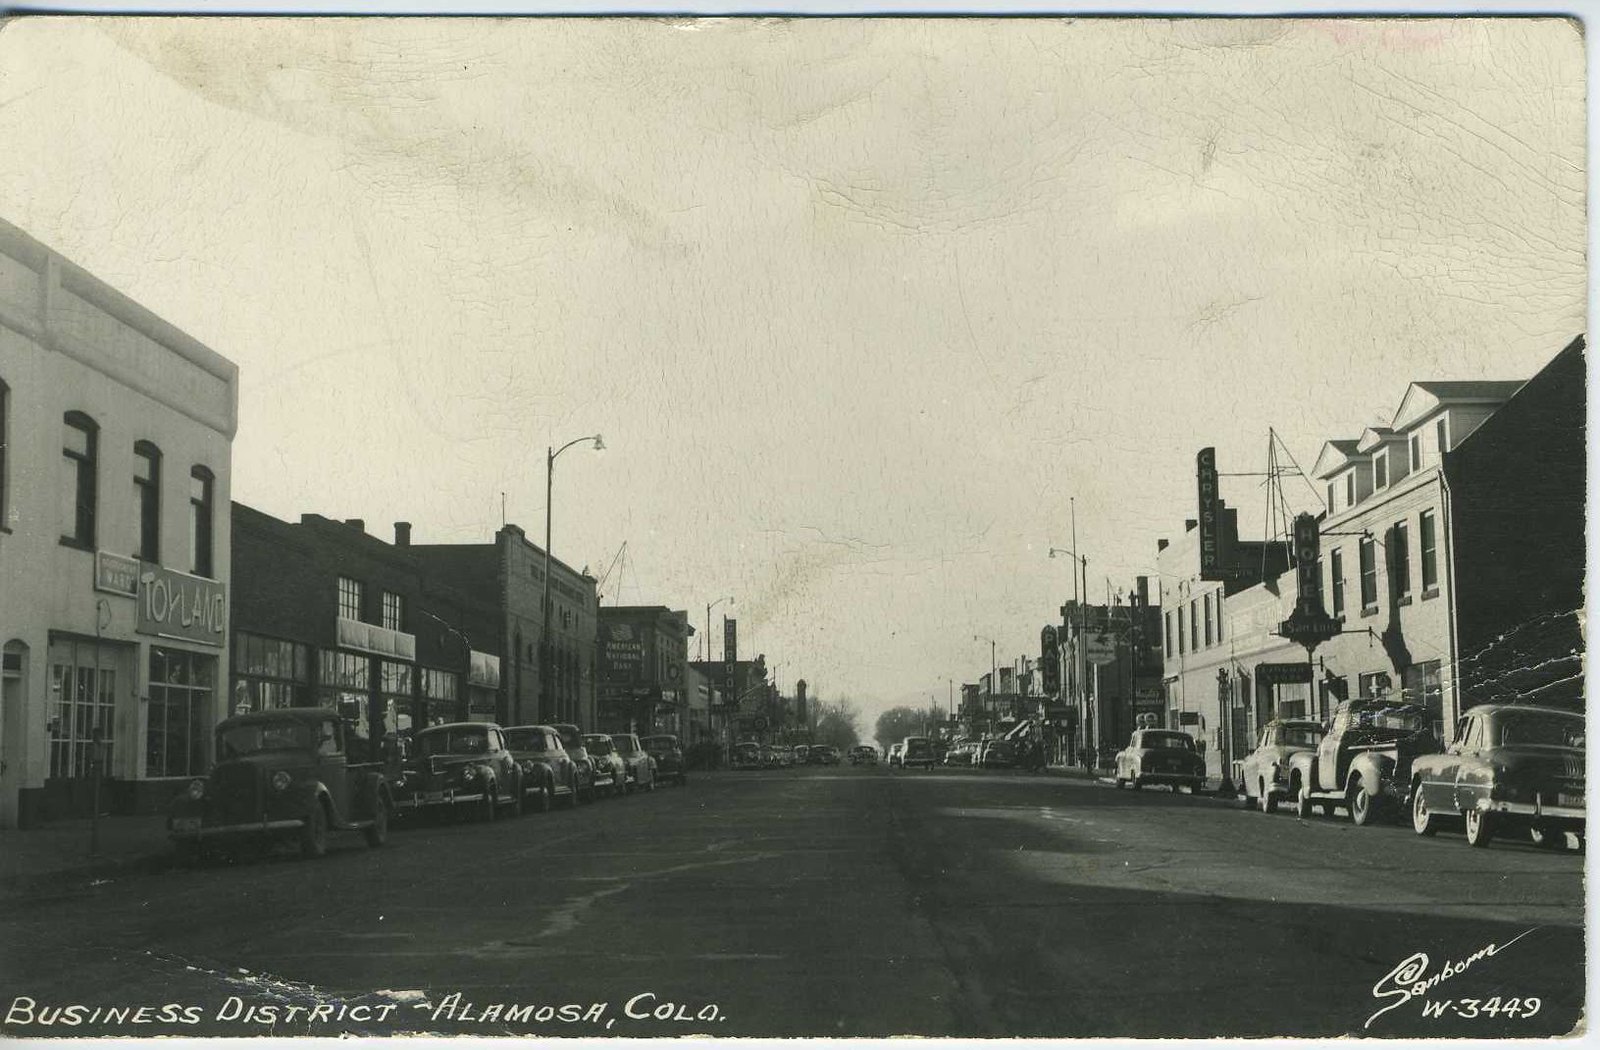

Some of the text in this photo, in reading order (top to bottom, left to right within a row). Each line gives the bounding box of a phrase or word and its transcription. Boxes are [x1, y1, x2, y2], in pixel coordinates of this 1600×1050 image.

[1201, 455, 1215, 566] CHRYSLER
[141, 571, 224, 632] TOYLAND
[1301, 527, 1318, 617] HOTEL
